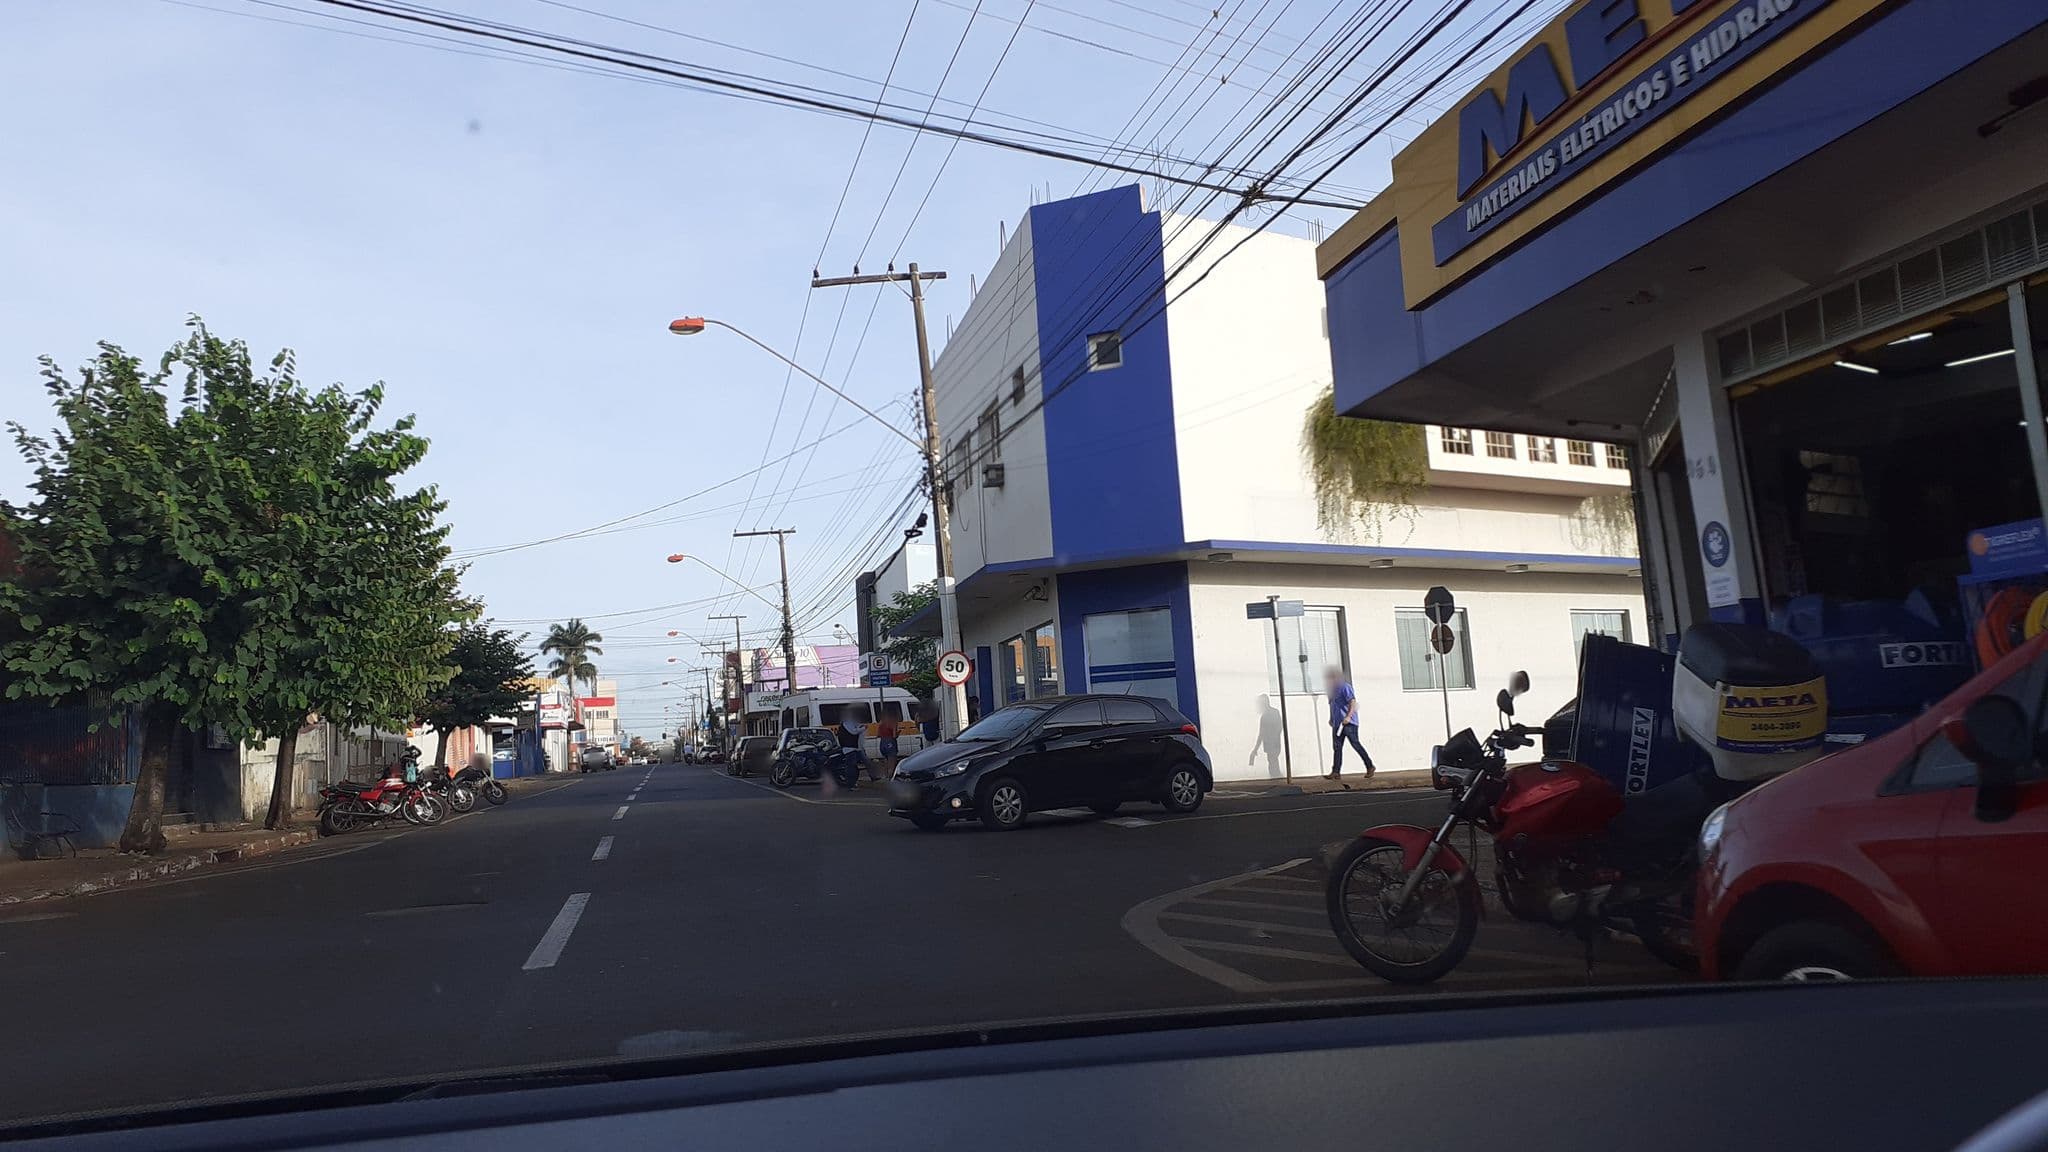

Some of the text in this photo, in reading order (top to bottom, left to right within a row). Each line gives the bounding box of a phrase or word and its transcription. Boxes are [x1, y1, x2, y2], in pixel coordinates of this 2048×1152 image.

[1457, 0, 1702, 202] ME
[1466, 148, 1556, 232] MATERIAIS
[1560, 70, 1668, 166] ELÉTRICOS
[1670, 54, 1691, 88] E
[945, 659, 965, 673] 50
[1725, 693, 1817, 708] META
[1628, 710, 1651, 794] ORTLEV
